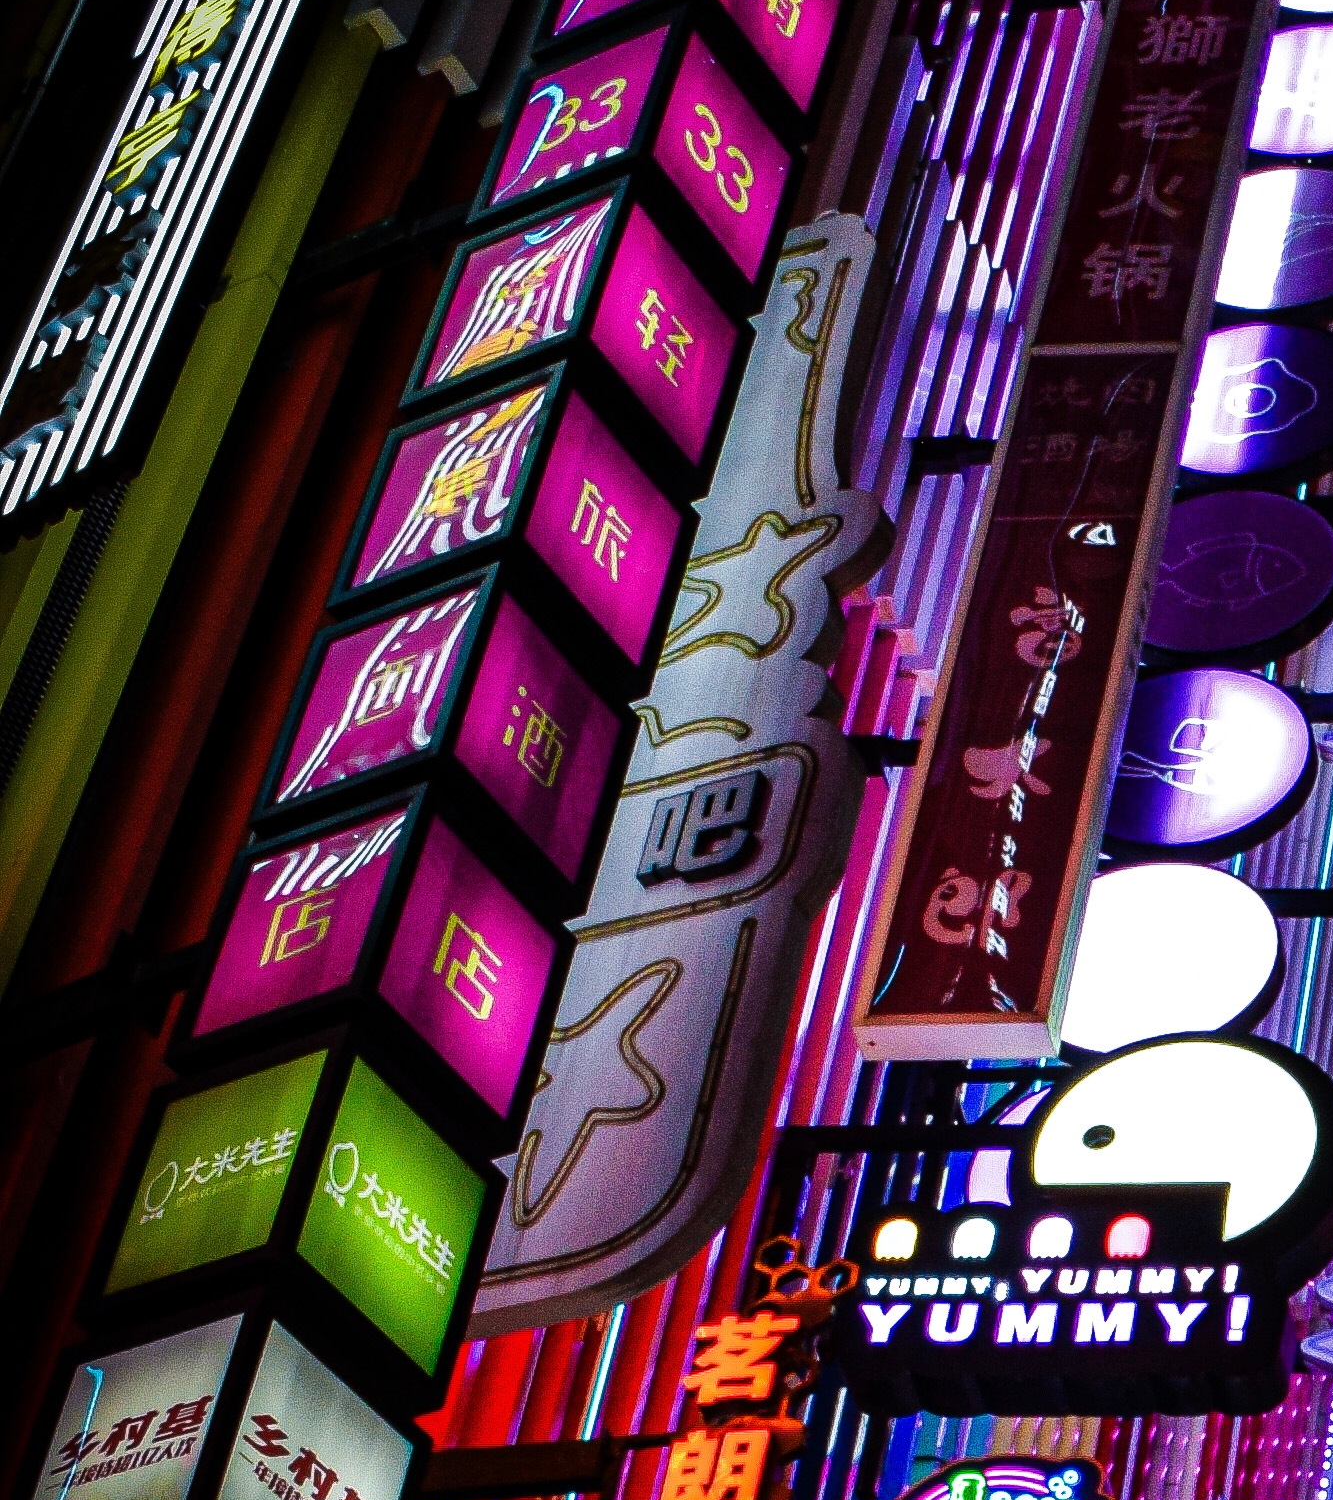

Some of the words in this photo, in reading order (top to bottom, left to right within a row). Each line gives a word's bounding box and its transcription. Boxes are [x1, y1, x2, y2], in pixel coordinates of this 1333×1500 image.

[643, 771, 767, 887] 吧
[180, 1127, 299, 1194] 大米先生
[357, 1171, 456, 1278] 大米先生
[1022, 1266, 1240, 1296] YUMMY!
[861, 1299, 1250, 1345] YUMMY!
[58, 1394, 214, 1472] 乡村基
